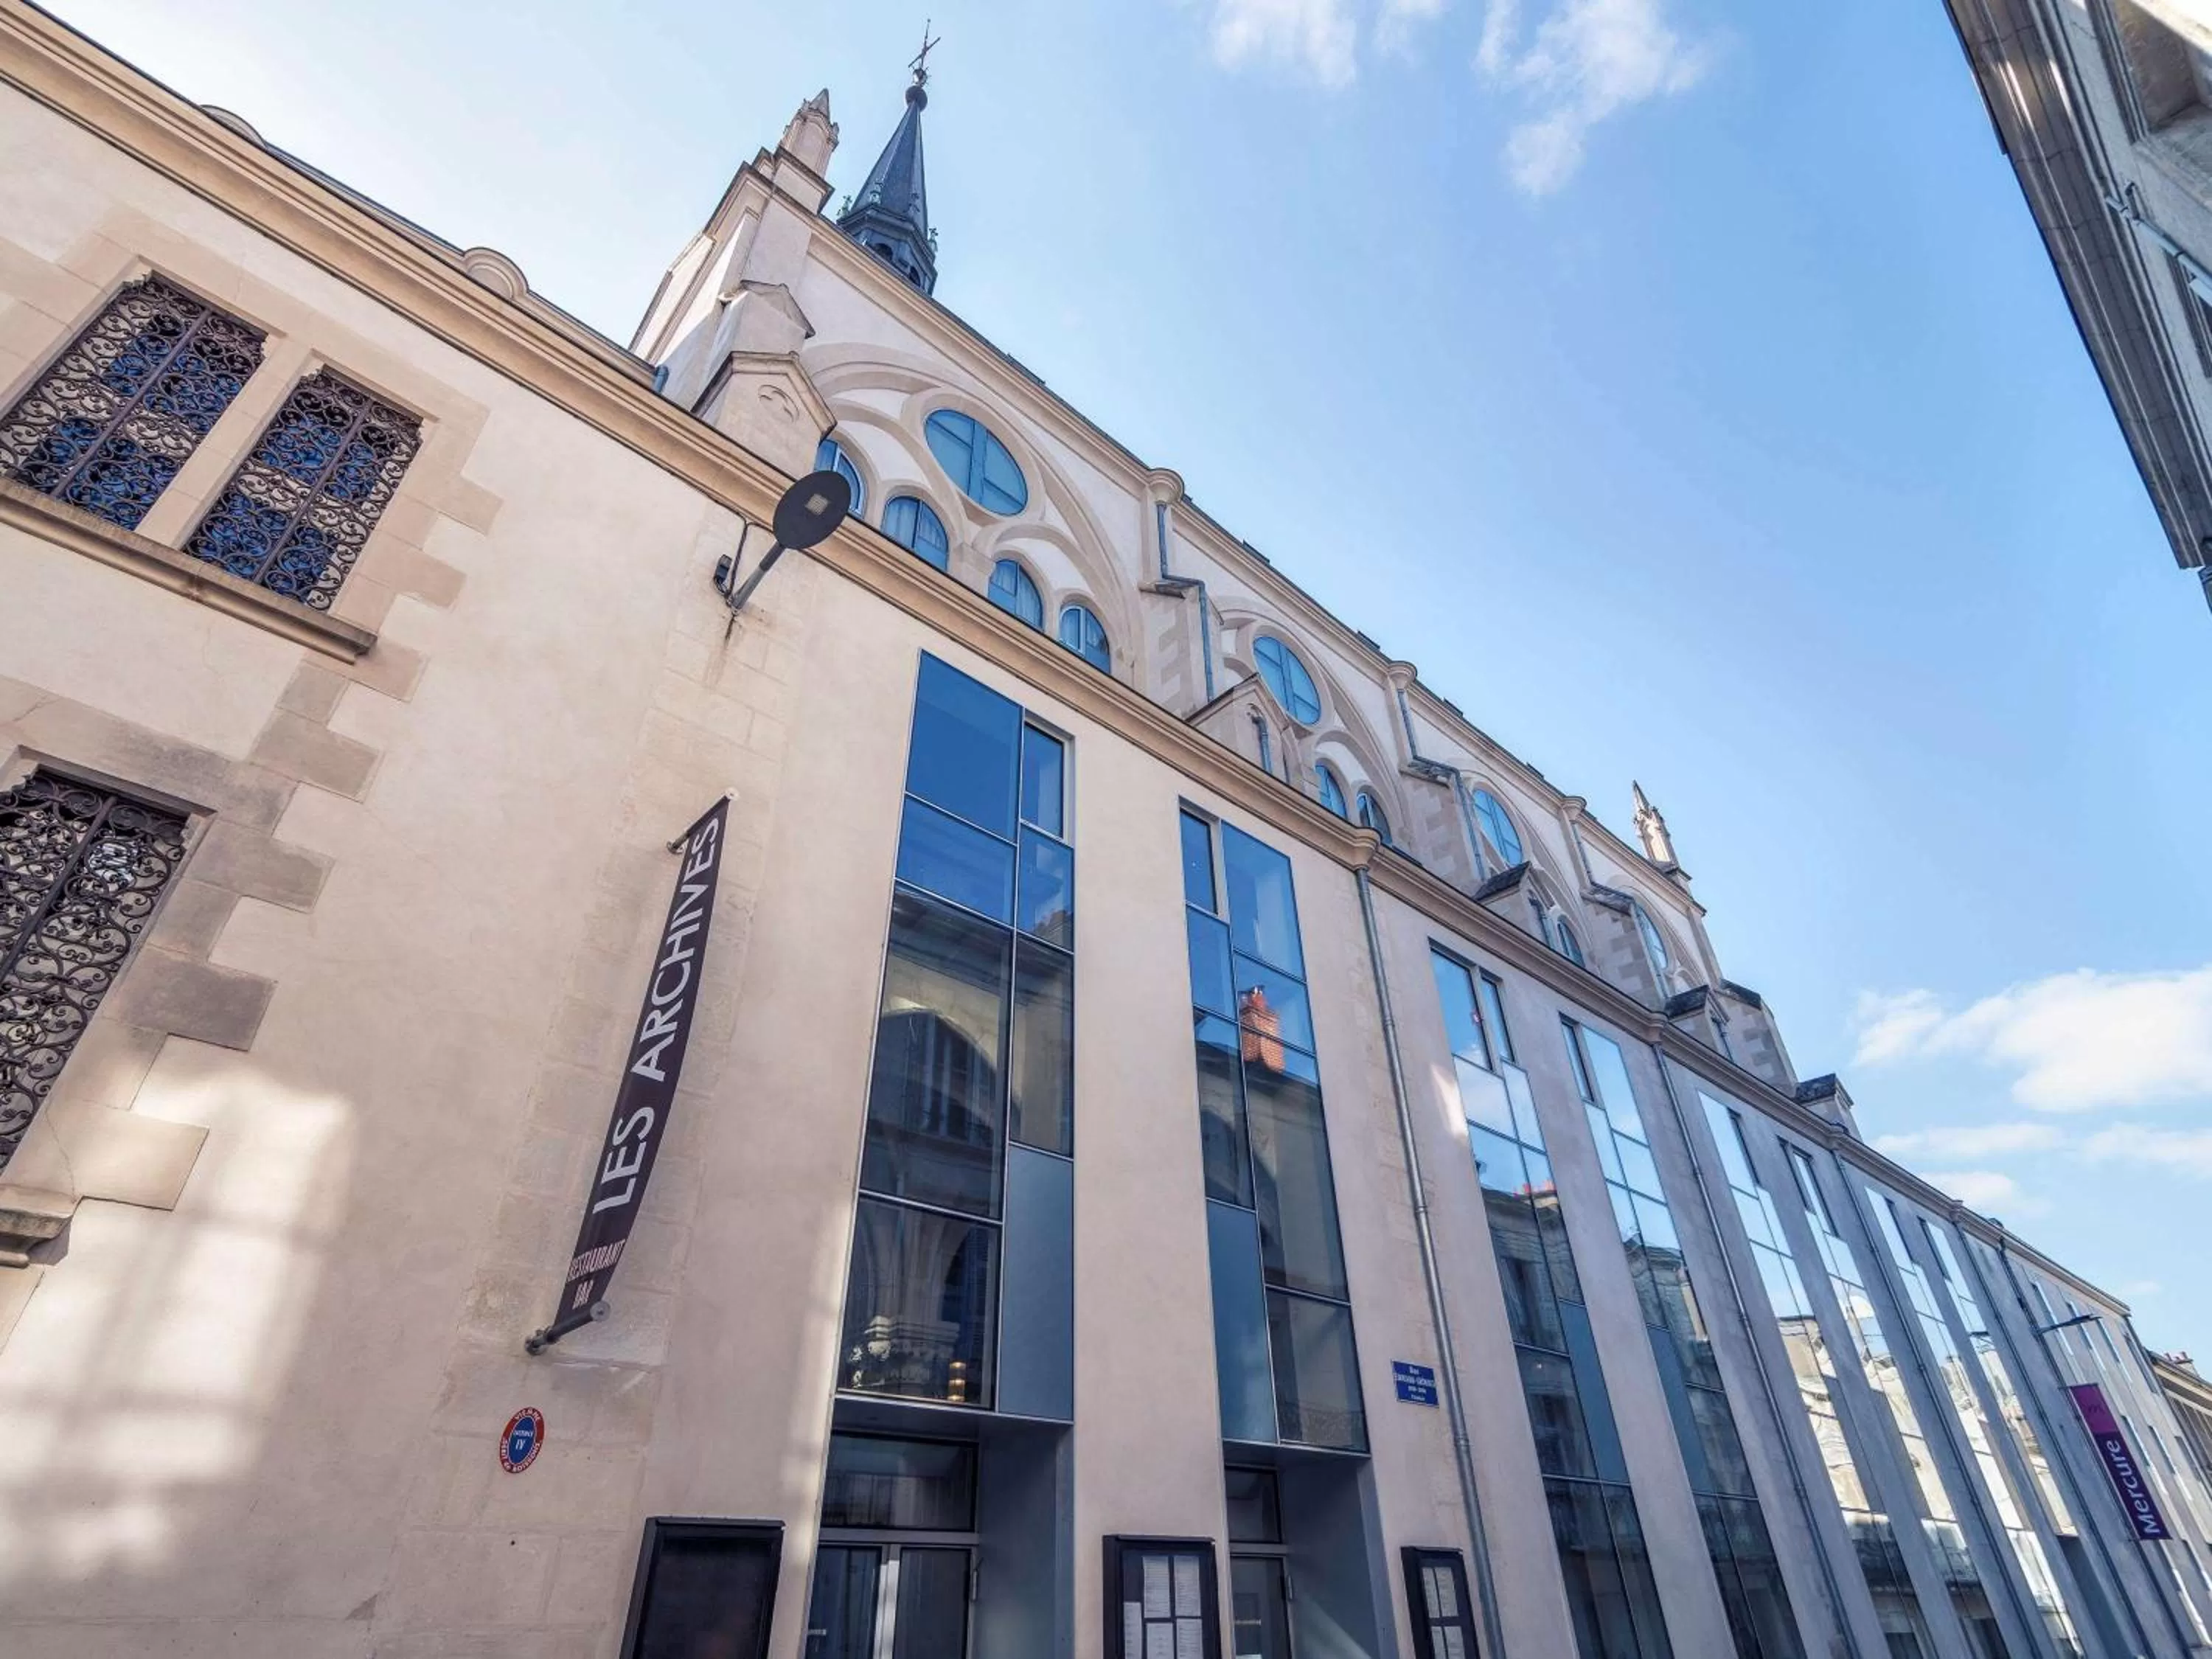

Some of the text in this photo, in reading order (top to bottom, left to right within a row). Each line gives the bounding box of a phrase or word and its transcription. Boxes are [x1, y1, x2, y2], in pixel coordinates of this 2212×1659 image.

[592, 817, 719, 1214] LES ARCHIVES
[567, 1239, 627, 1283] RESTAURANT
[2106, 1439, 2161, 1534] Mercure
